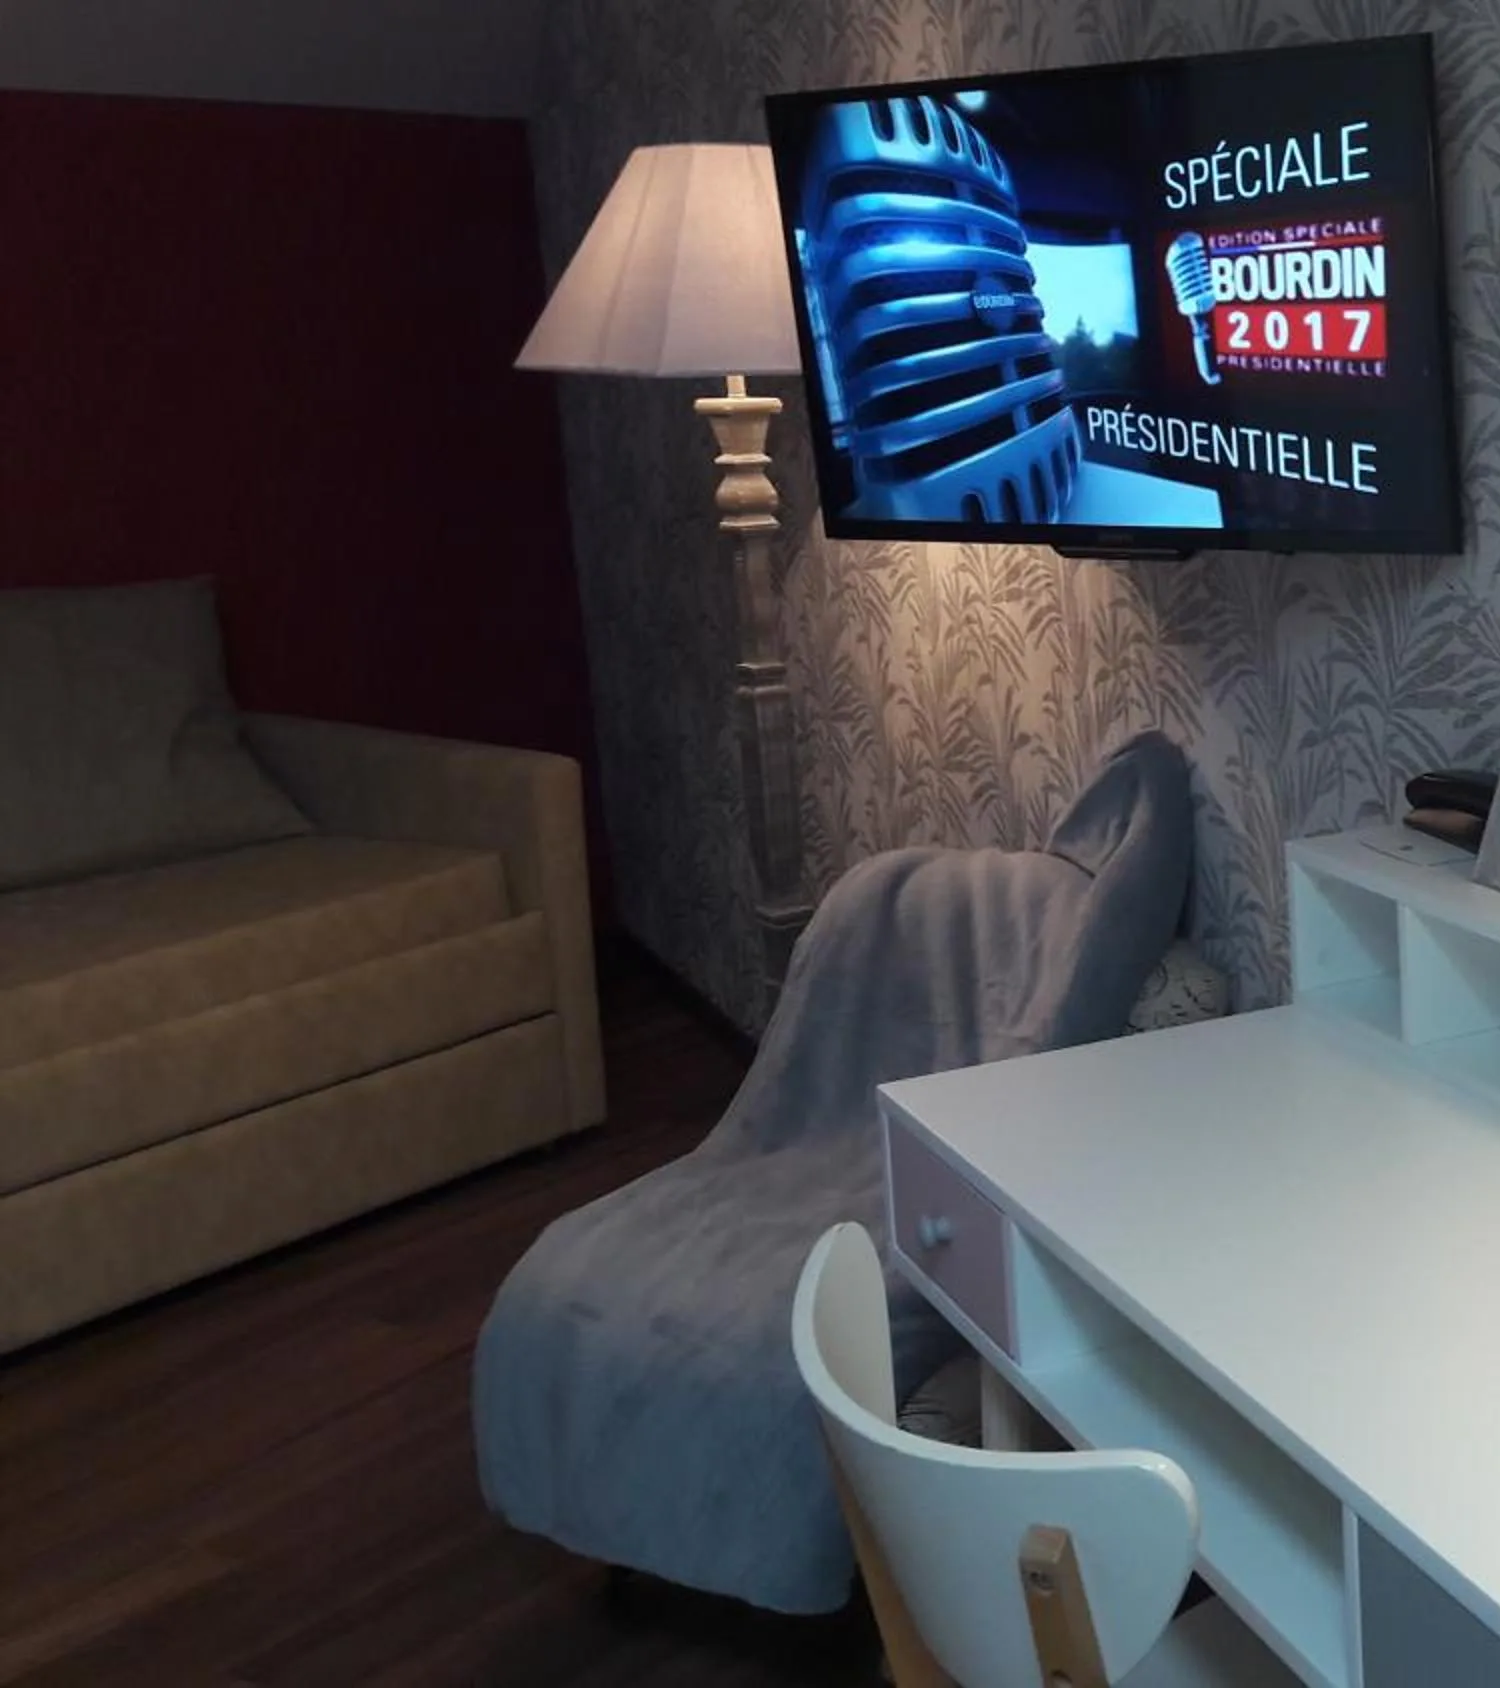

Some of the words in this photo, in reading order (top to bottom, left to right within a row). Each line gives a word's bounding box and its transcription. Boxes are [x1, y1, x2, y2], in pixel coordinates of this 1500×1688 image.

[1164, 121, 1371, 209] SPÉCIALE
[1283, 217, 1382, 241] SPECIALE
[1210, 245, 1387, 302] BOURDIN
[1227, 309, 1372, 352] 2017
[1216, 354, 1387, 377] PRESIDENTIELLE
[1086, 402, 1379, 494] PRÉSIDENTIELLE
